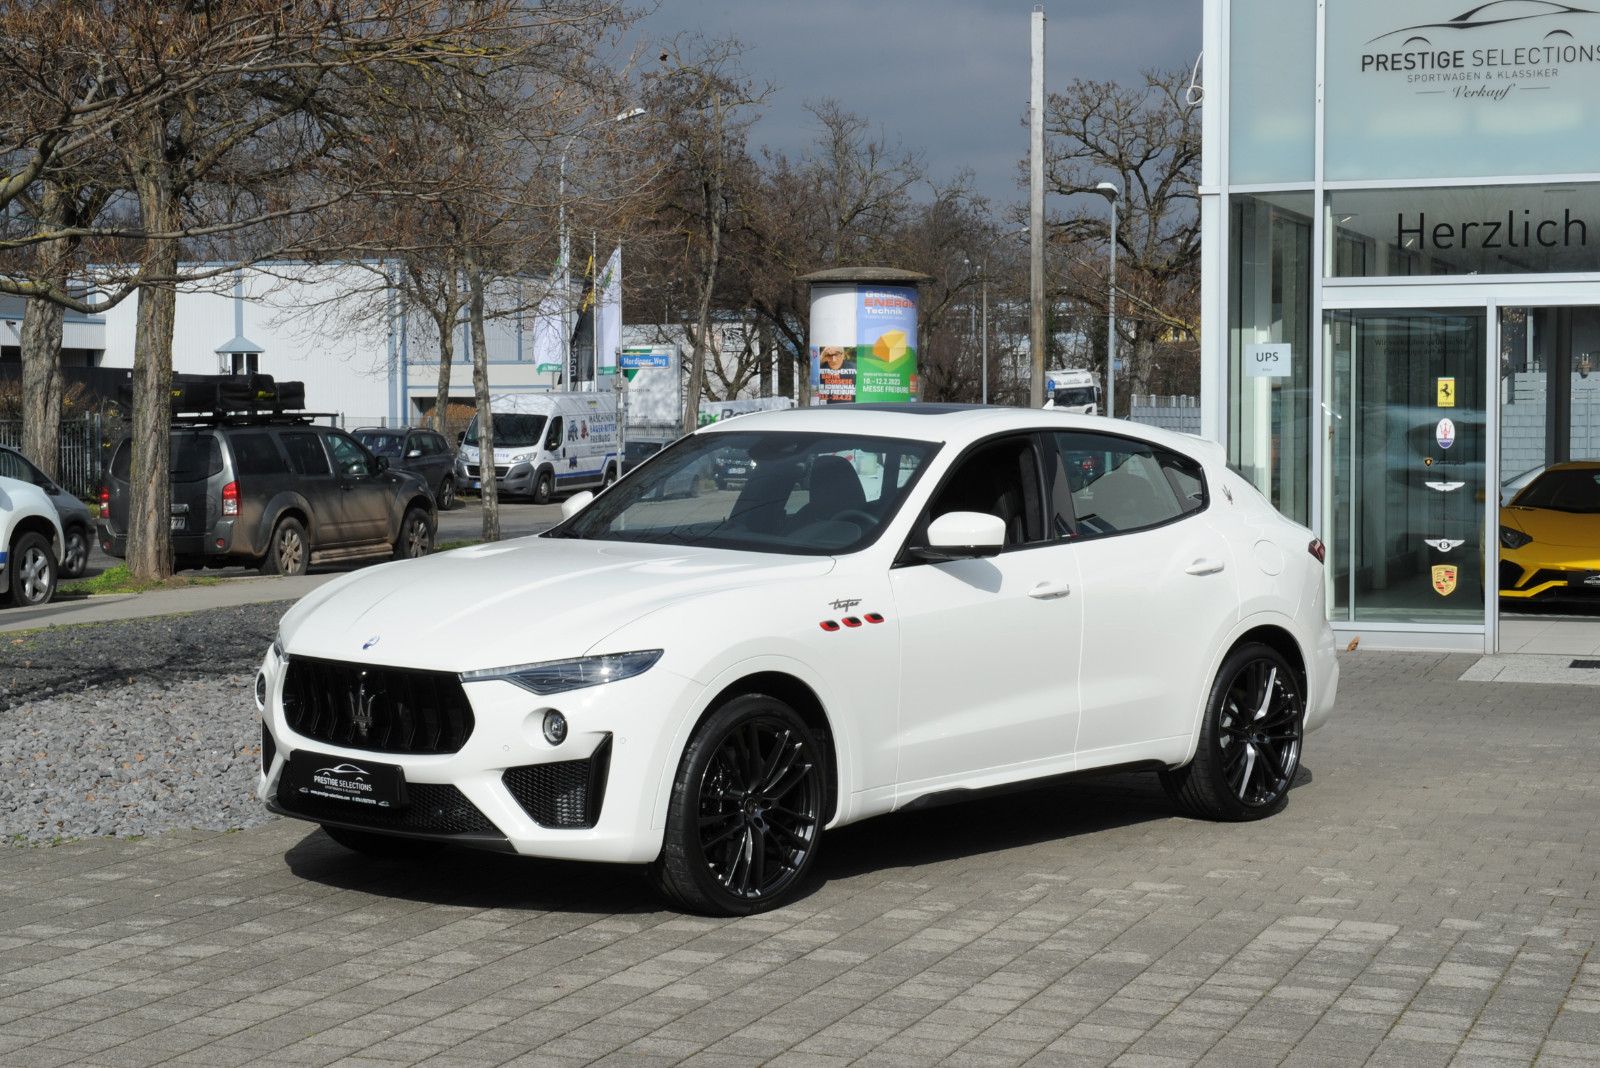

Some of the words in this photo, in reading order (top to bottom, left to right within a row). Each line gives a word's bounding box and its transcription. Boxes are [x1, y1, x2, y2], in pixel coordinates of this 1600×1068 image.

[1361, 50, 1465, 72] PRESTIGE
[1407, 72, 1481, 83] SPORTWAGEN
[1485, 71, 1492, 80] &
[1497, 68, 1559, 79] KLASSIKER
[1452, 83, 1516, 101] Verkauf
[1398, 208, 1587, 250] Herzlich
[654, 357, 666, 366] Weg
[1256, 351, 1279, 363] UPS
[862, 385, 884, 393] MESSE
[313, 775, 339, 787] PRESTIGE
[339, 780, 373, 792] SELECTIONS
